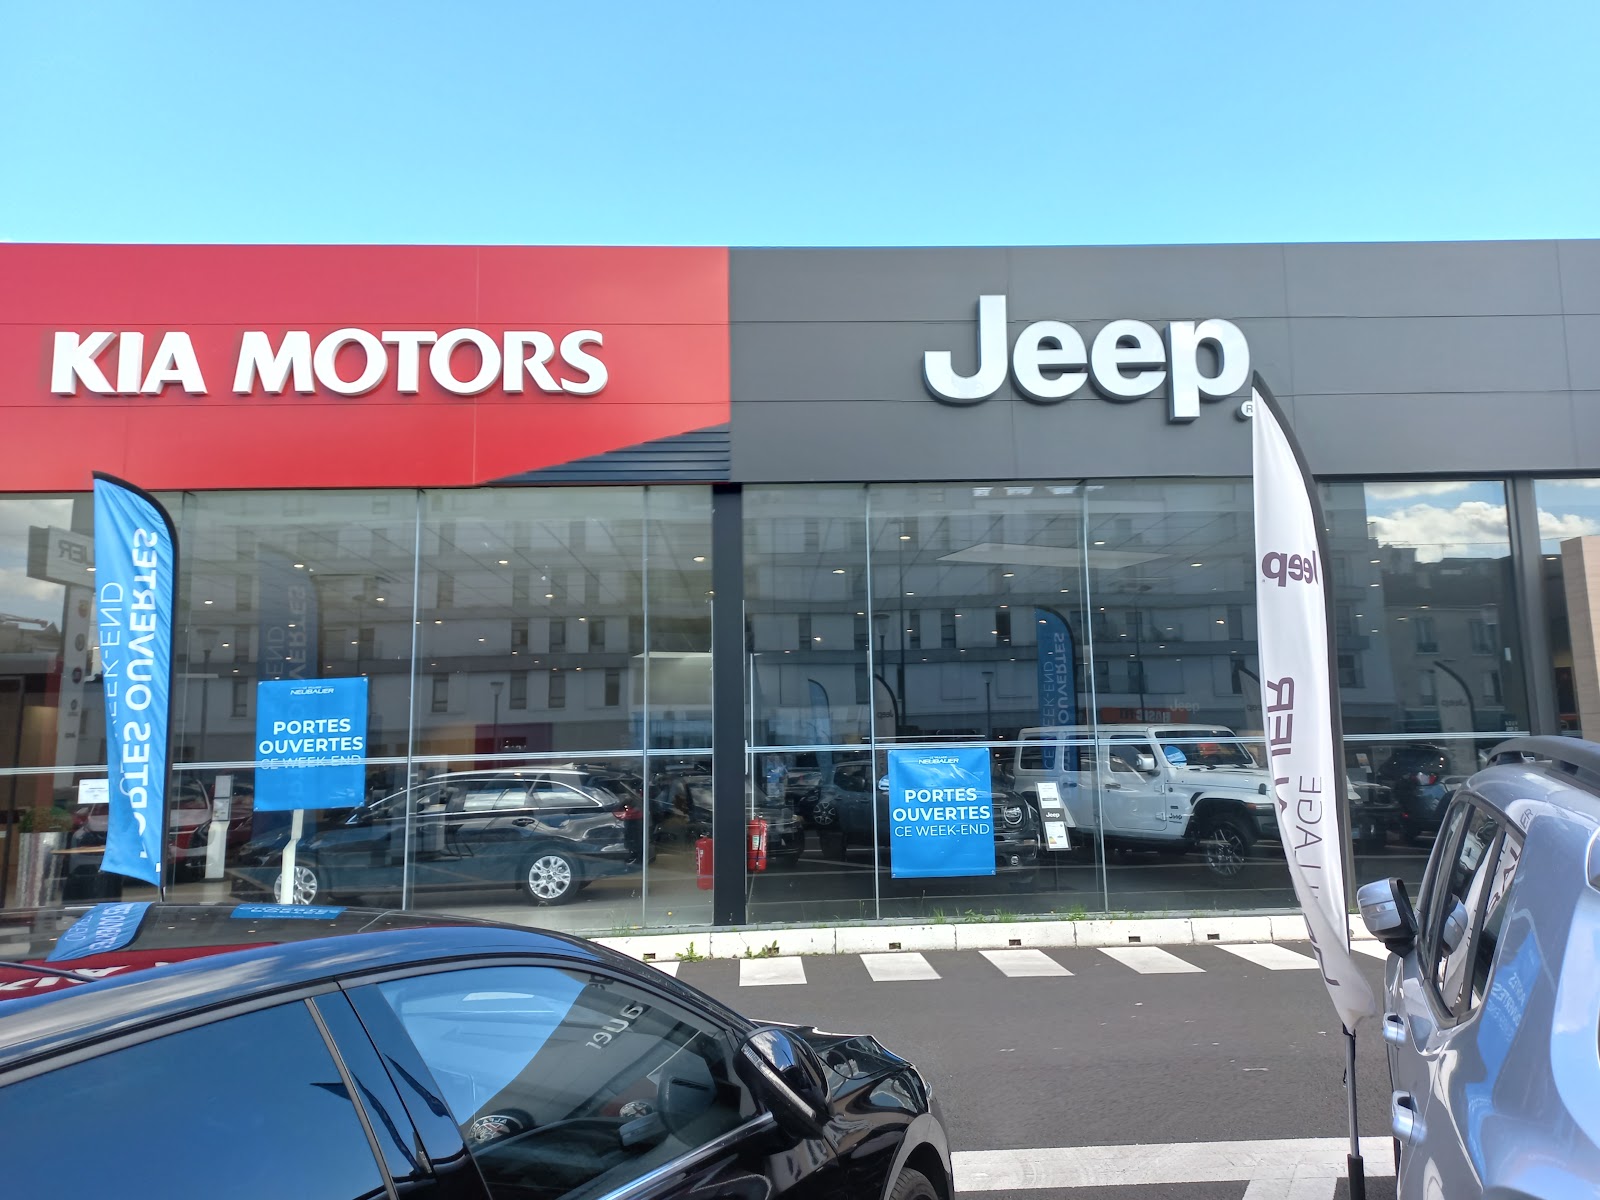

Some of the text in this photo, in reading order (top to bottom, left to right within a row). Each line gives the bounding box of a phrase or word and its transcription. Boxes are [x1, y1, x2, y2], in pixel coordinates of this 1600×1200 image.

[51, 328, 608, 396] KIA MOTORS
[924, 295, 1250, 421] Jeep
[273, 718, 351, 735] PORTES
[259, 736, 363, 754] OUVERTES
[905, 788, 977, 803] PORTES
[893, 806, 990, 822] OUVERTES
[895, 823, 990, 837] CE WEEK-END
